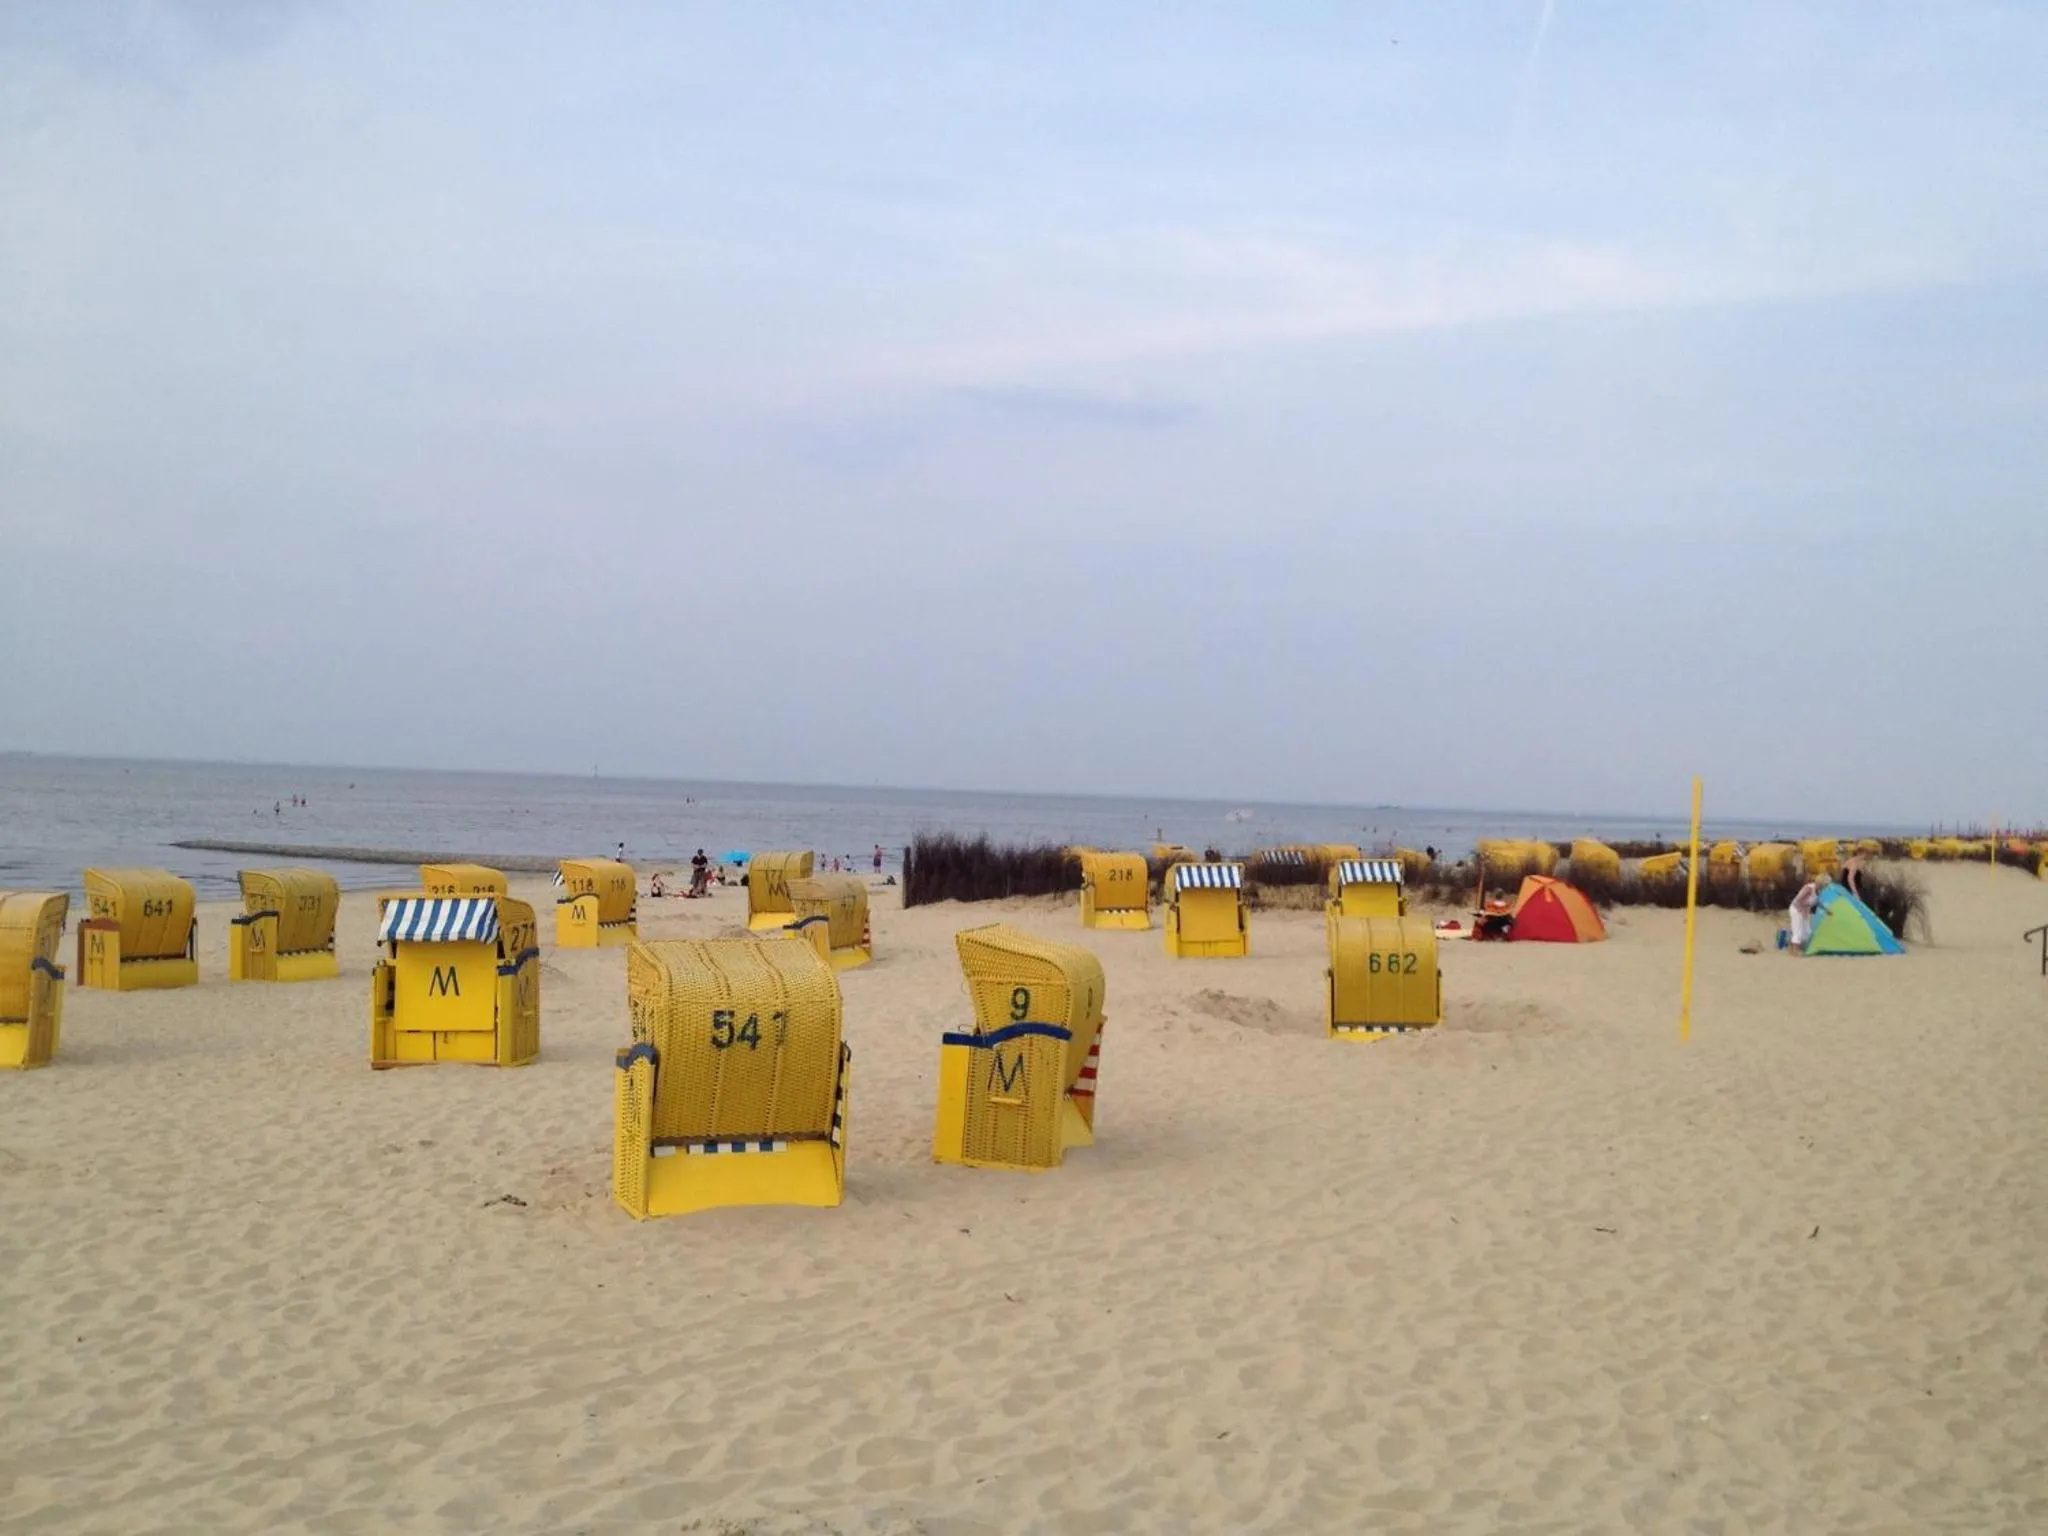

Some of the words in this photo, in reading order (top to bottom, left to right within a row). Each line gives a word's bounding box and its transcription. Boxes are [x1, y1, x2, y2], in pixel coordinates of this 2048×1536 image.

[571, 878, 594, 893] 118
[1109, 868, 1133, 882] 218
[143, 899, 174, 917] 641
[571, 904, 587, 921] M
[1368, 952, 1417, 975] 662
[429, 966, 460, 997] M
[1010, 986, 1030, 1021] 9
[711, 1009, 789, 1051] 541
[987, 1052, 1030, 1098] M
